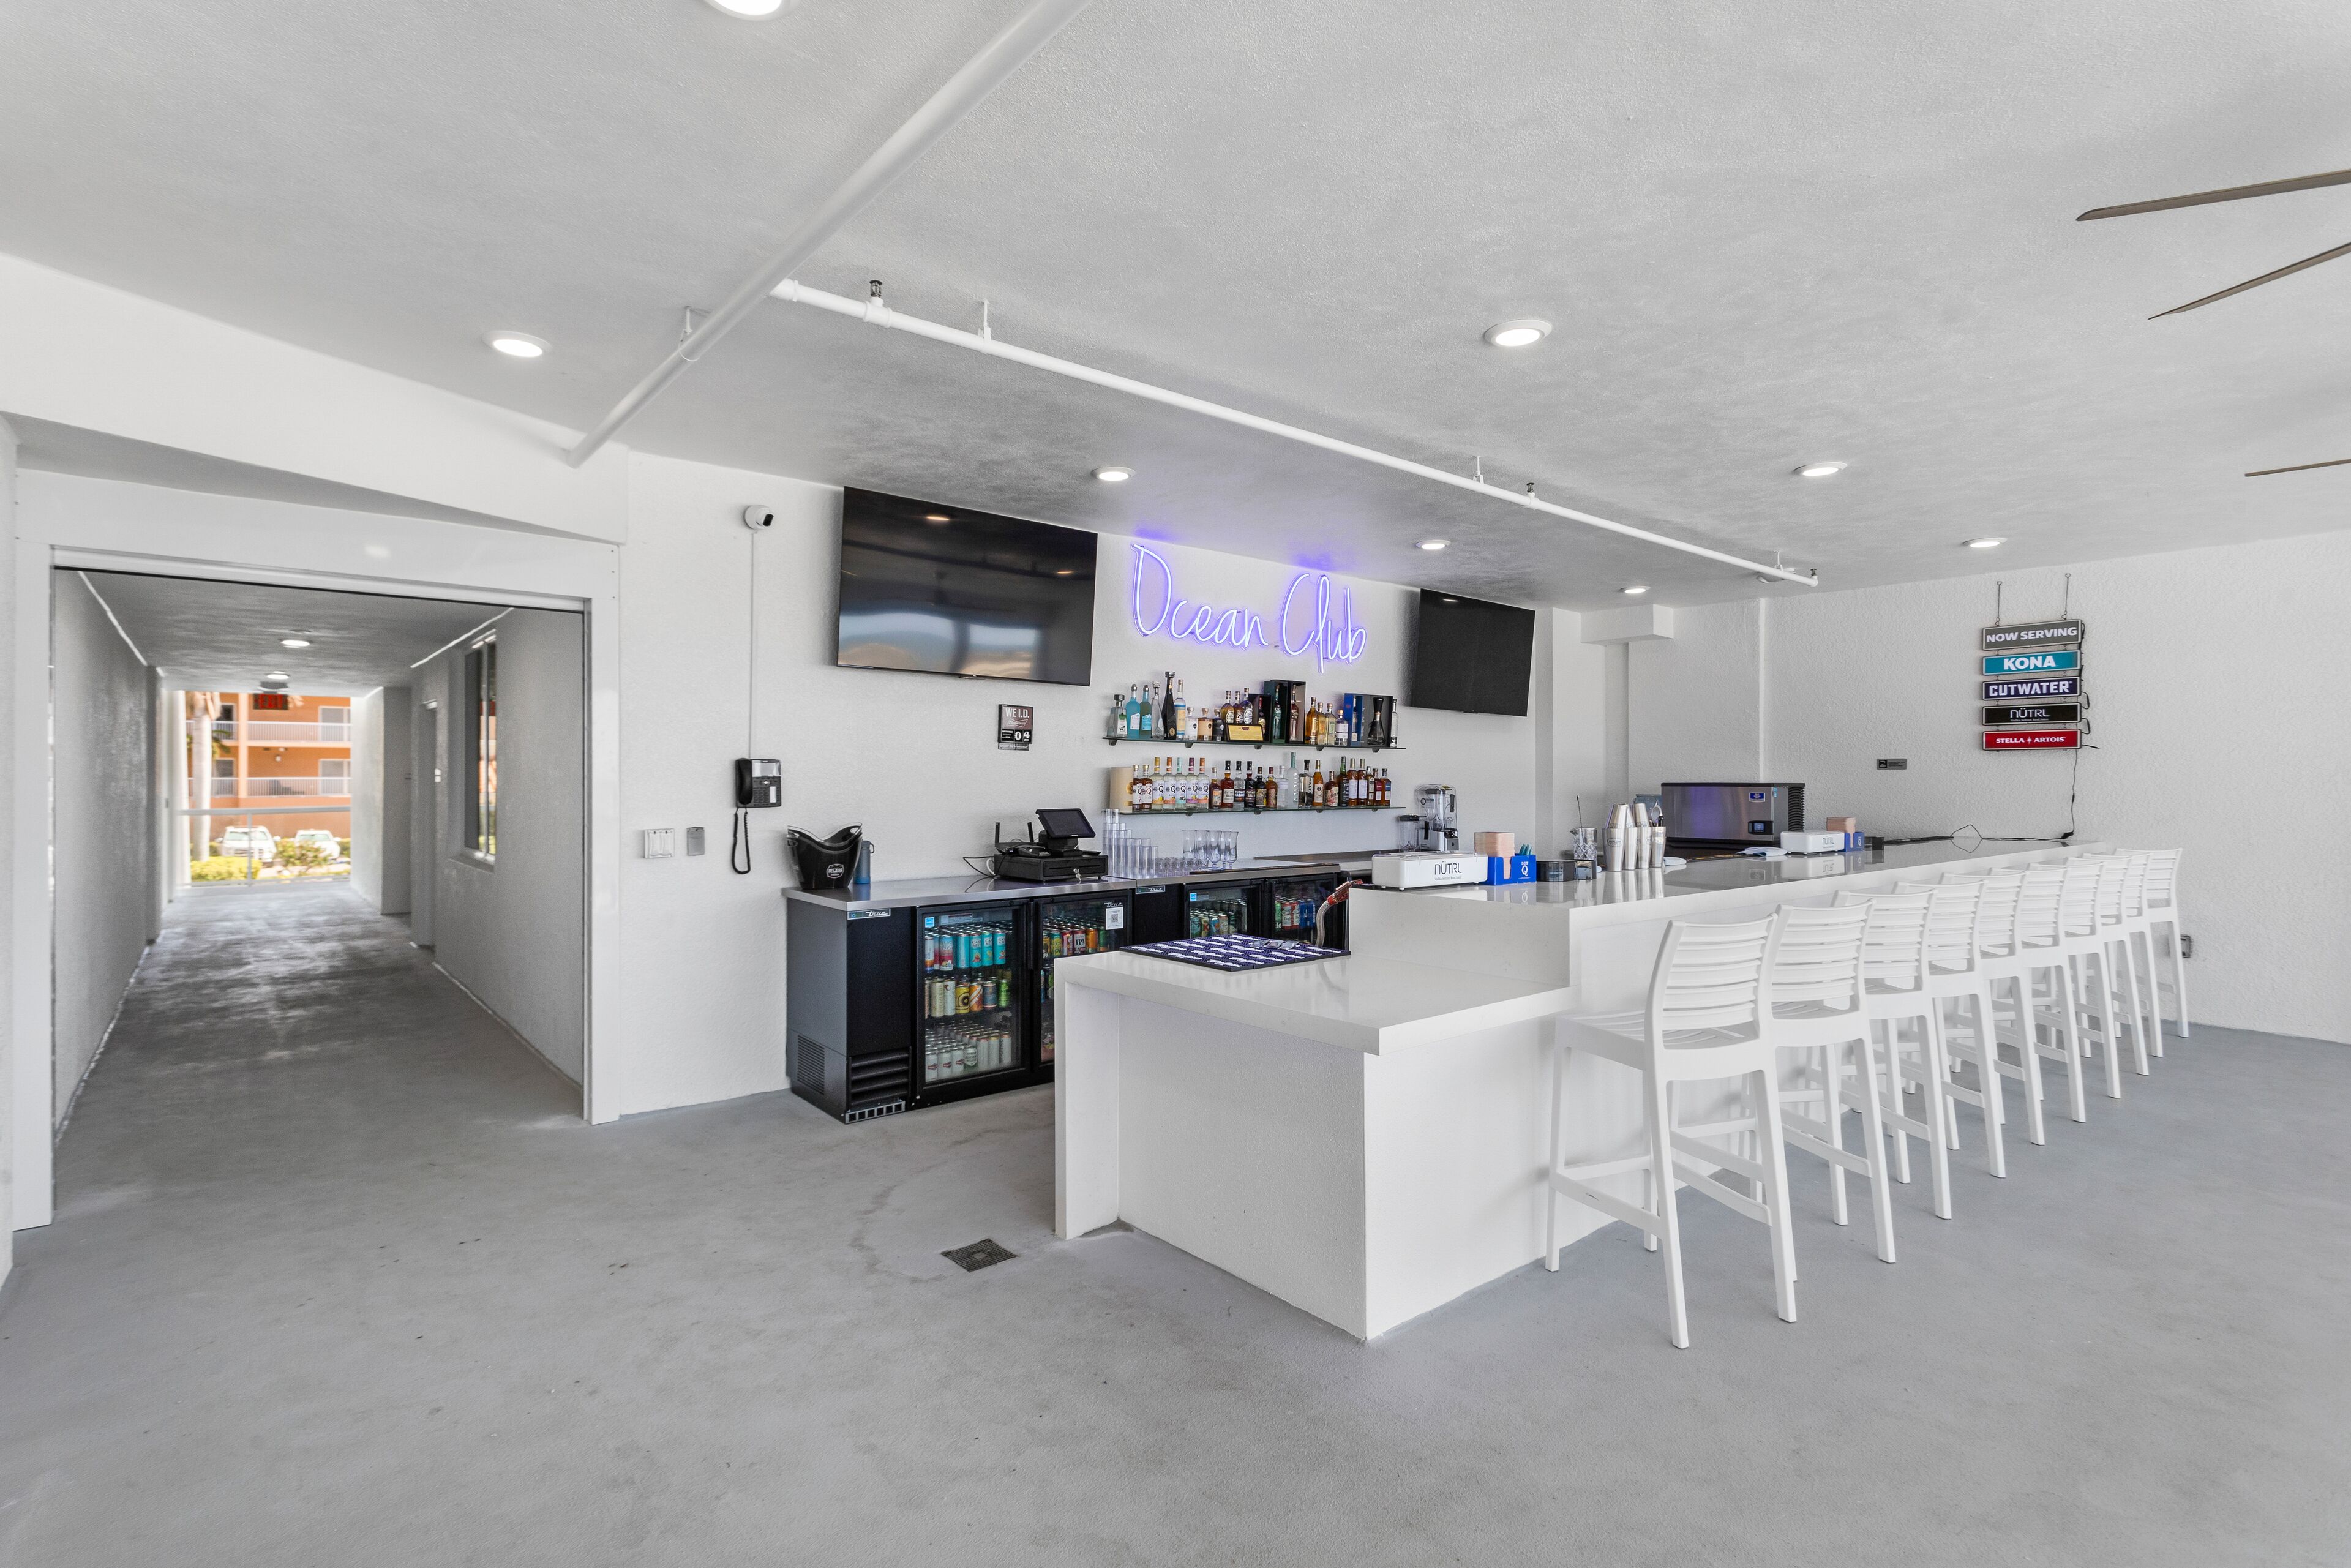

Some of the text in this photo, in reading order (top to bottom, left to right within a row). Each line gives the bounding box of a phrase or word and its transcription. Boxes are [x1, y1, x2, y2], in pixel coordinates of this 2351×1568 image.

[1282, 573, 1367, 673] Club
[1986, 626, 2077, 643] NOW SERVING
[2003, 655, 2057, 670] KONA
[1989, 681, 2070, 696] CUTWATER
[1005, 708, 1029, 718] WE I.D.
[1158, 785, 1164, 793] Q
[1180, 785, 1186, 793] Q
[1203, 785, 1209, 793] Q
[1521, 865, 1529, 876] Q
